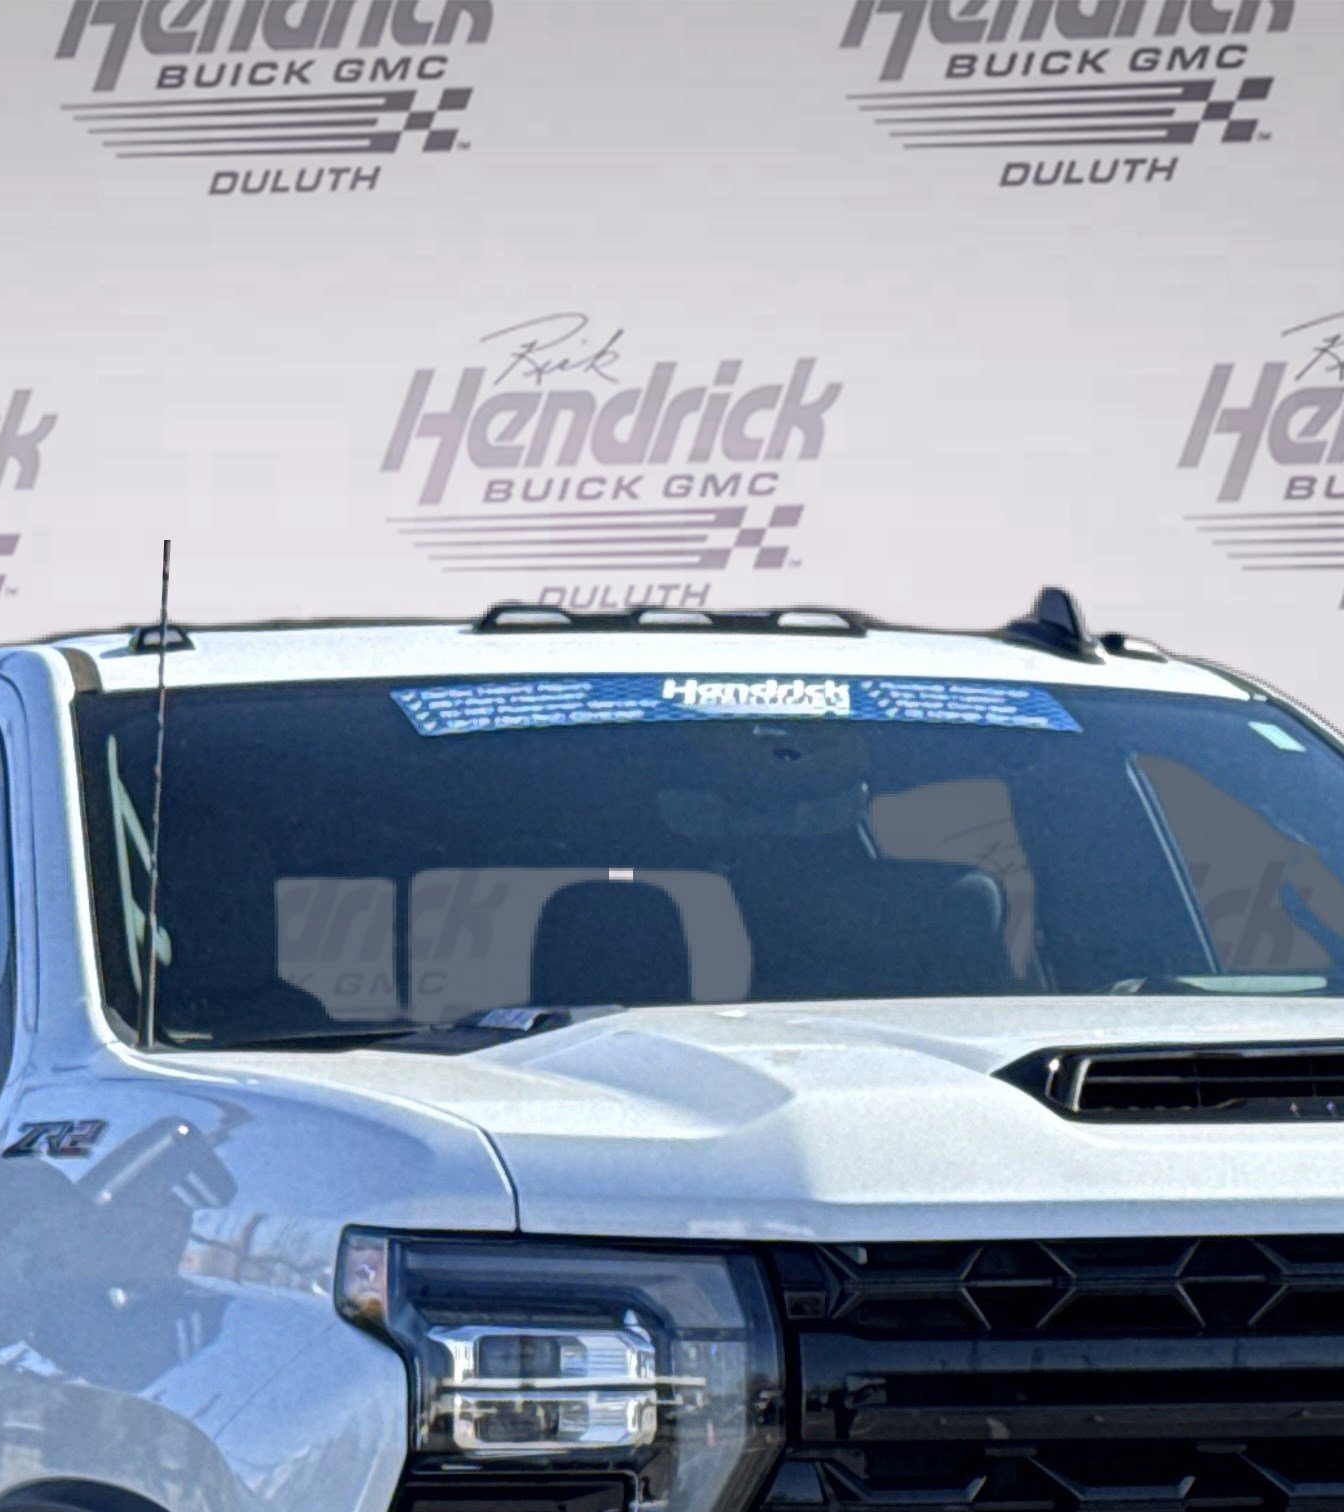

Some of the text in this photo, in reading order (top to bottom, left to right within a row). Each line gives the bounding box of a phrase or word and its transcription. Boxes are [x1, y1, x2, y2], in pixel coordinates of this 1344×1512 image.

[156, 55, 448, 89] BUICK GMC
[945, 44, 1248, 79] BUICK GMC
[209, 166, 381, 195] DULUTH
[1000, 157, 1178, 187] DULUTH
[379, 357, 844, 506] Hendrick
[483, 472, 779, 503] BUICK GMC
[536, 583, 711, 610] DULUTH
